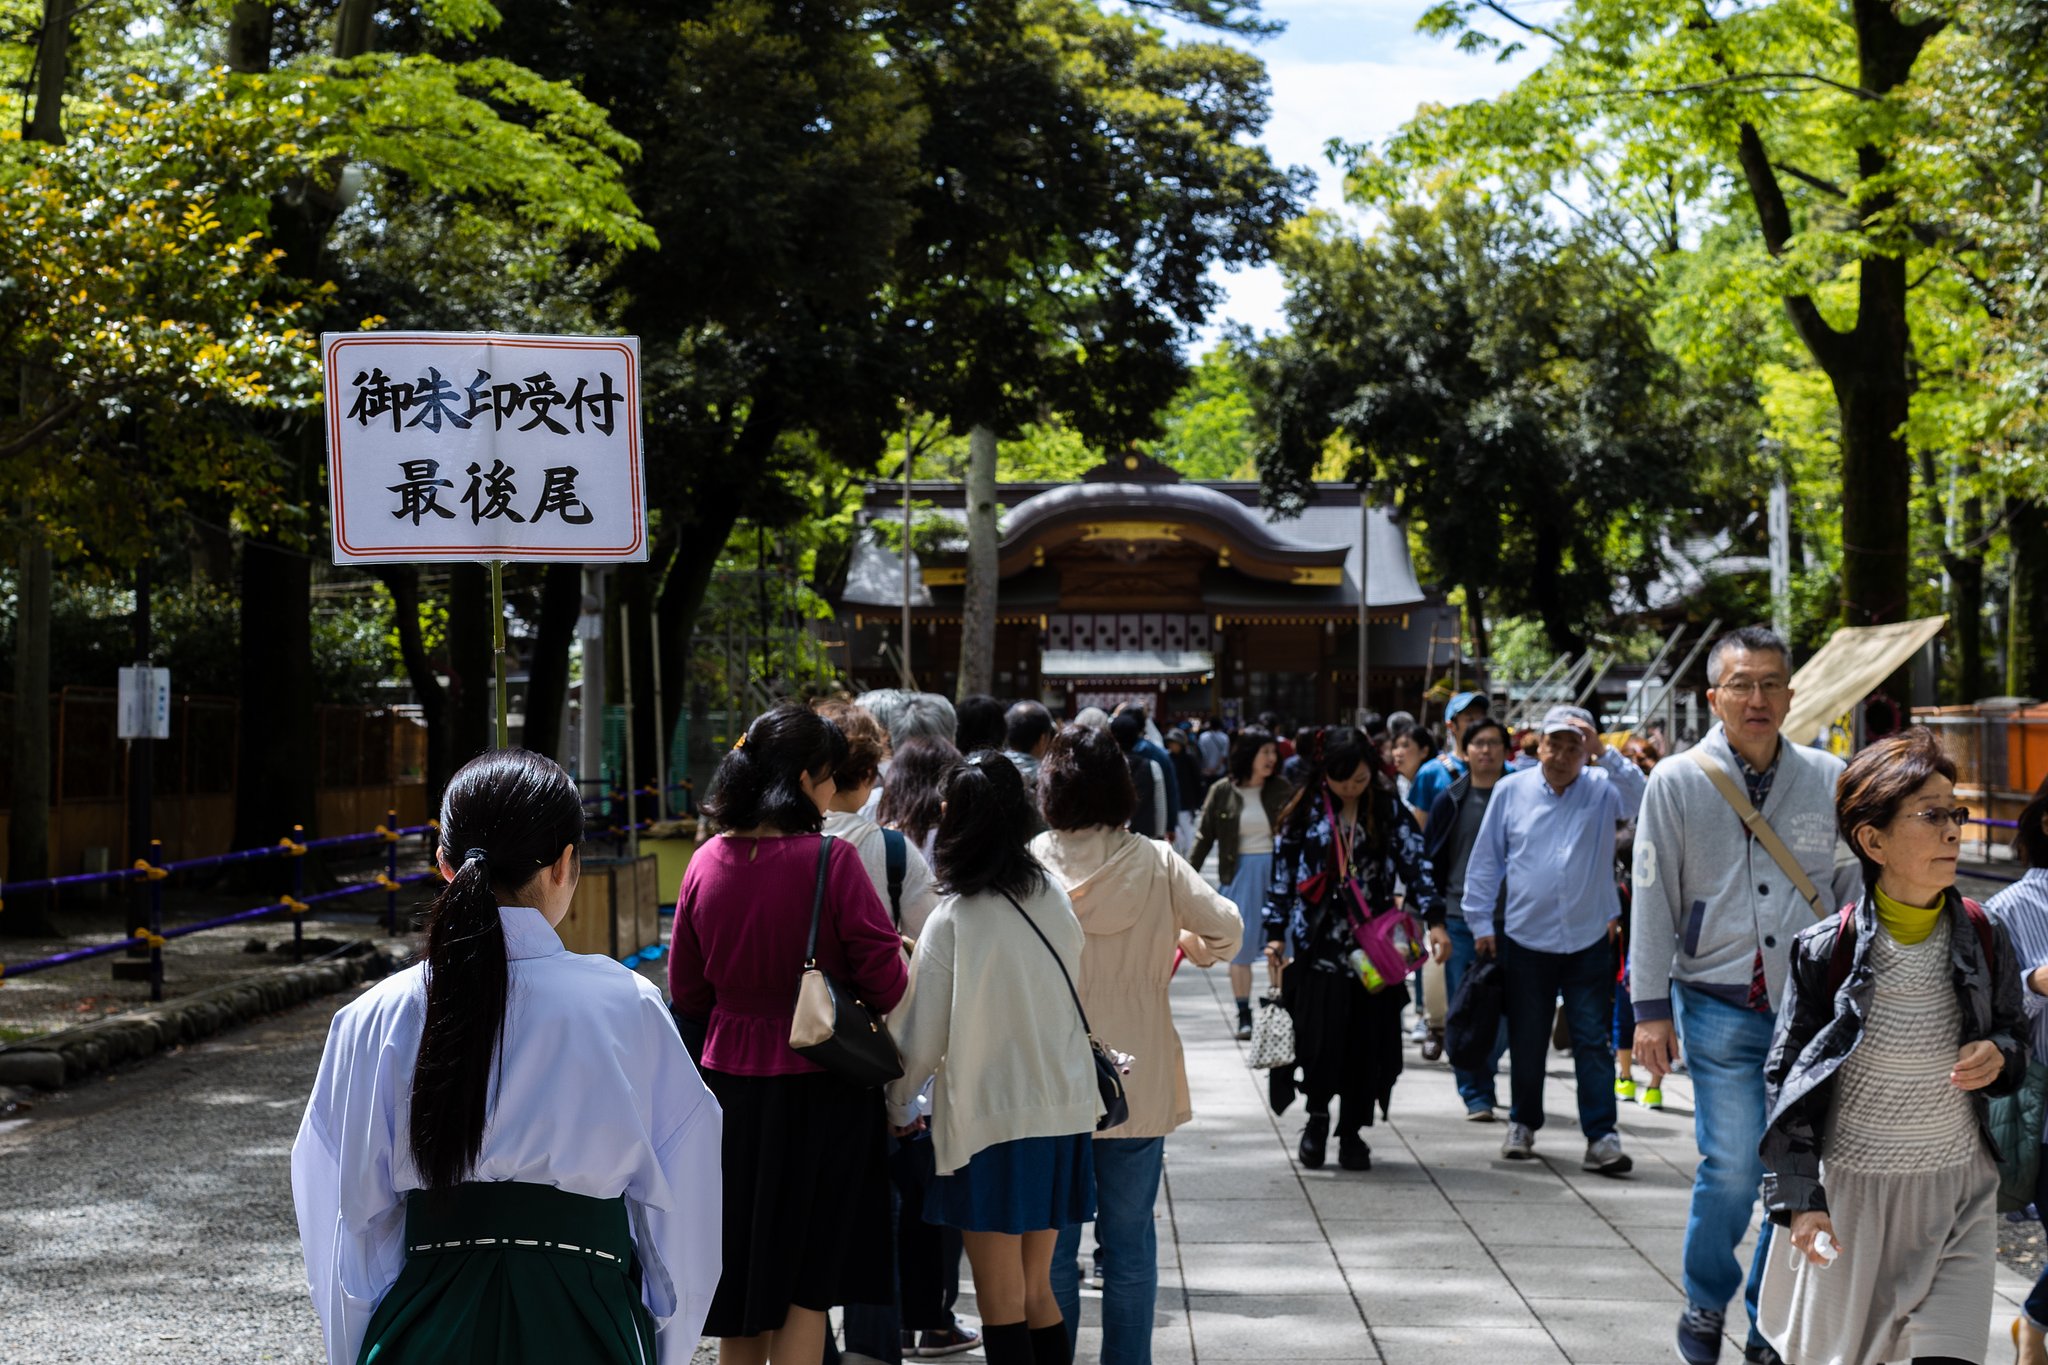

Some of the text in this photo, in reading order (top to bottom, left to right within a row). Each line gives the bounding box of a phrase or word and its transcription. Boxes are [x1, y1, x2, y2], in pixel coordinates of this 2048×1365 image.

[347, 366, 624, 436] 御朱印受付
[386, 459, 594, 526] 最後尾
